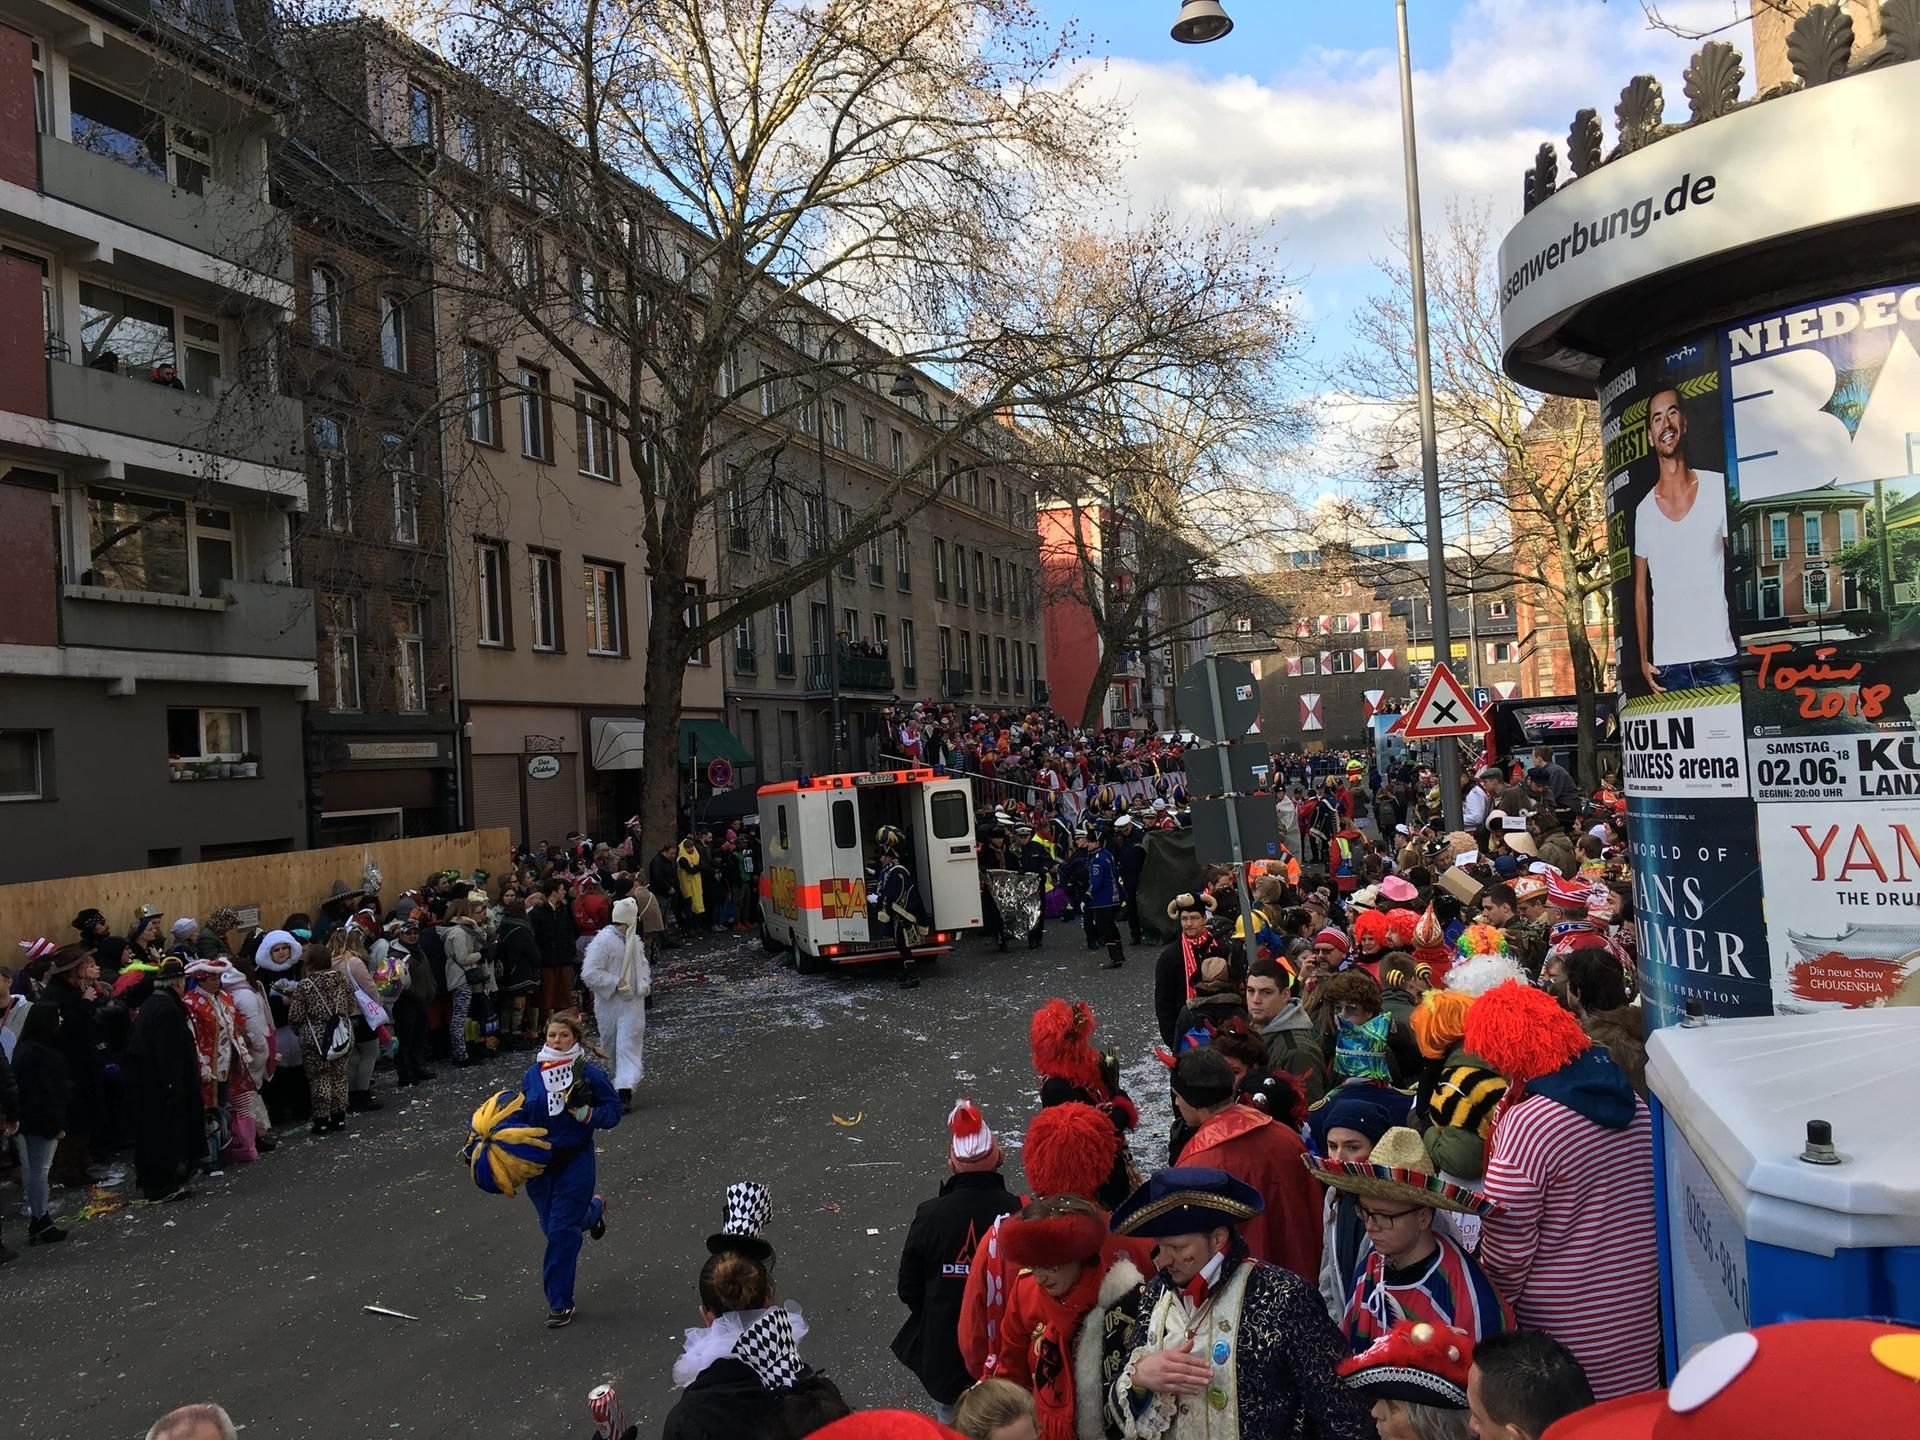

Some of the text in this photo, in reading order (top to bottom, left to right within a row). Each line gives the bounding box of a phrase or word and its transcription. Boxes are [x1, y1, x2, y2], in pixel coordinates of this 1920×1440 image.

[1794, 683, 1892, 720] 2018
[1766, 741, 1829, 754] SAMSTAG
[1626, 752, 1740, 779] LANXESS arena
[1757, 758, 1846, 787] 02.06.
[1759, 788, 1843, 798] BEGINN: 20:00 UHR
[1633, 840, 1728, 862] WORLD OF
[1837, 892, 1920, 906] THE DRU
[1809, 966, 1884, 980] Die neue Show
[1810, 979, 1883, 993] CHOUSENSHA
